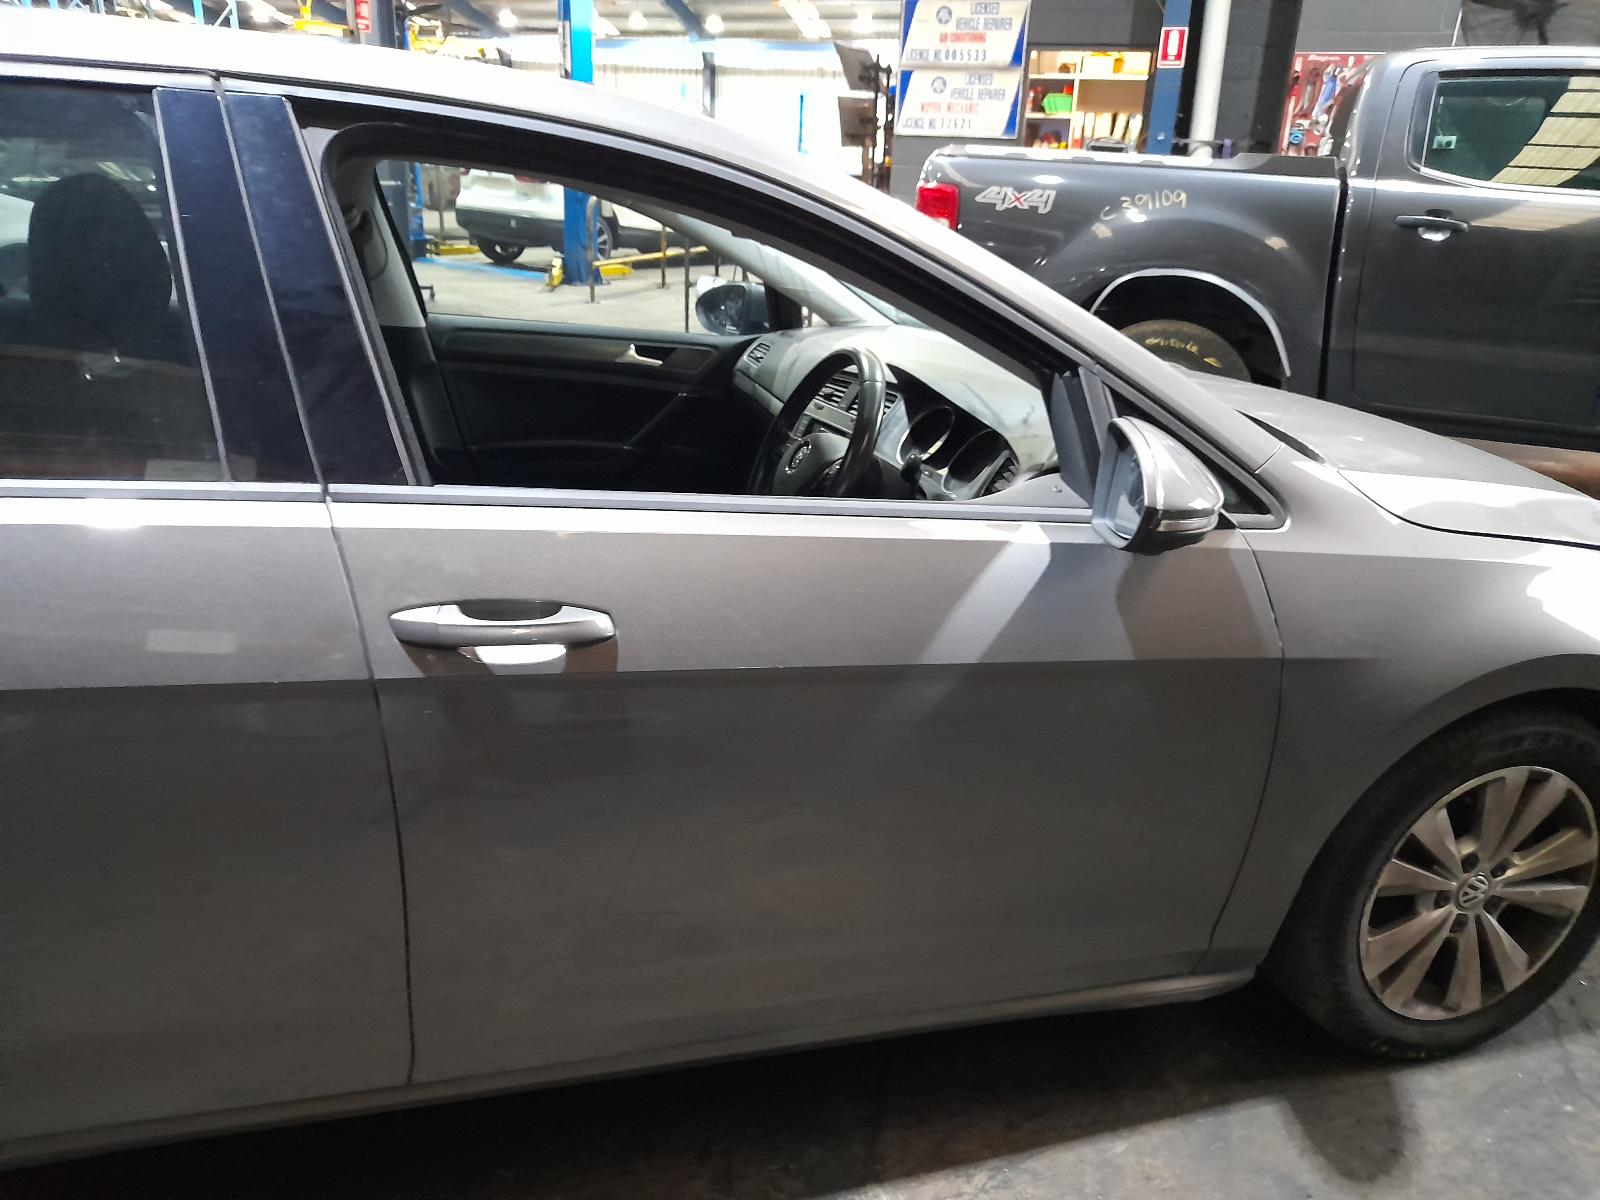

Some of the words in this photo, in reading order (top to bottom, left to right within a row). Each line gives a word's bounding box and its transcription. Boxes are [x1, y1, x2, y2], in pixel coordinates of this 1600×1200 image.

[955, 17, 980, 30] VEHICLE
[983, 18, 1013, 31] REPAIRER
[951, 88, 973, 100] VEHICLE
[978, 88, 1006, 101] REPAIRER
